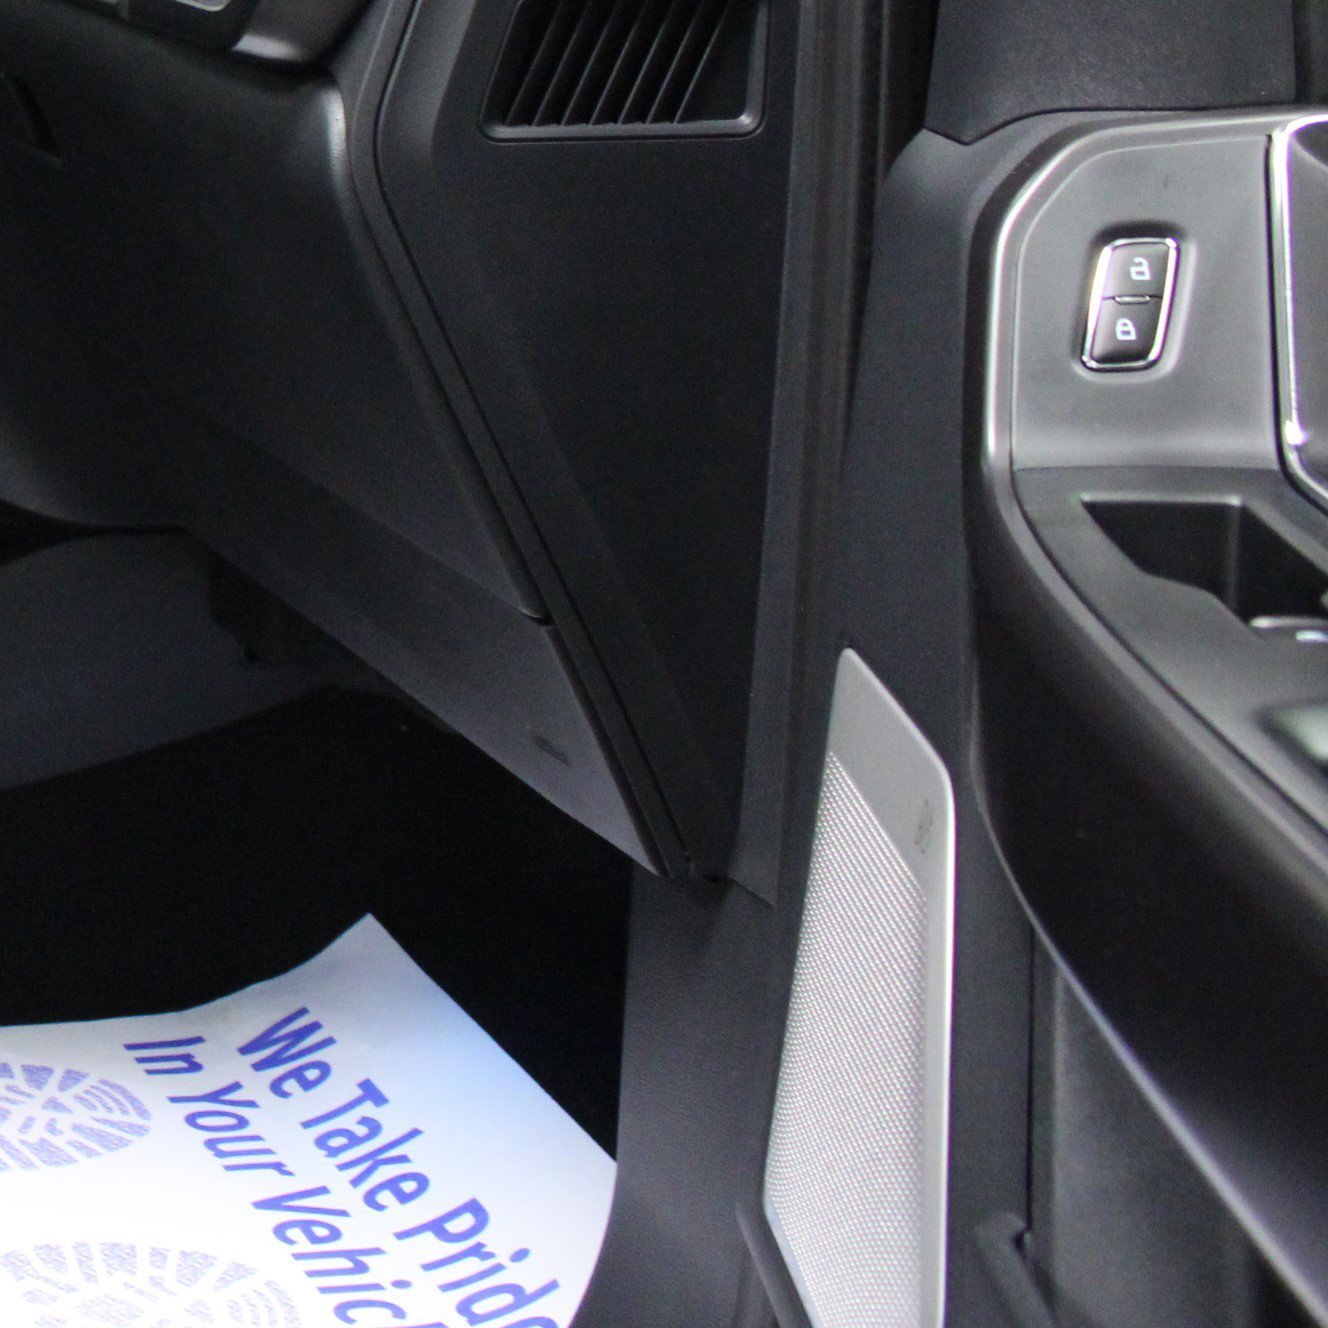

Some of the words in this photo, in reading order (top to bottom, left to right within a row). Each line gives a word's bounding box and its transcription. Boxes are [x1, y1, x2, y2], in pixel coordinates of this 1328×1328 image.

[123, 1036, 206, 1075] In
[167, 1081, 295, 1177] Your
[252, 1185, 451, 1328] Vehic
[237, 1007, 337, 1099] We
[300, 1078, 431, 1212] Take
